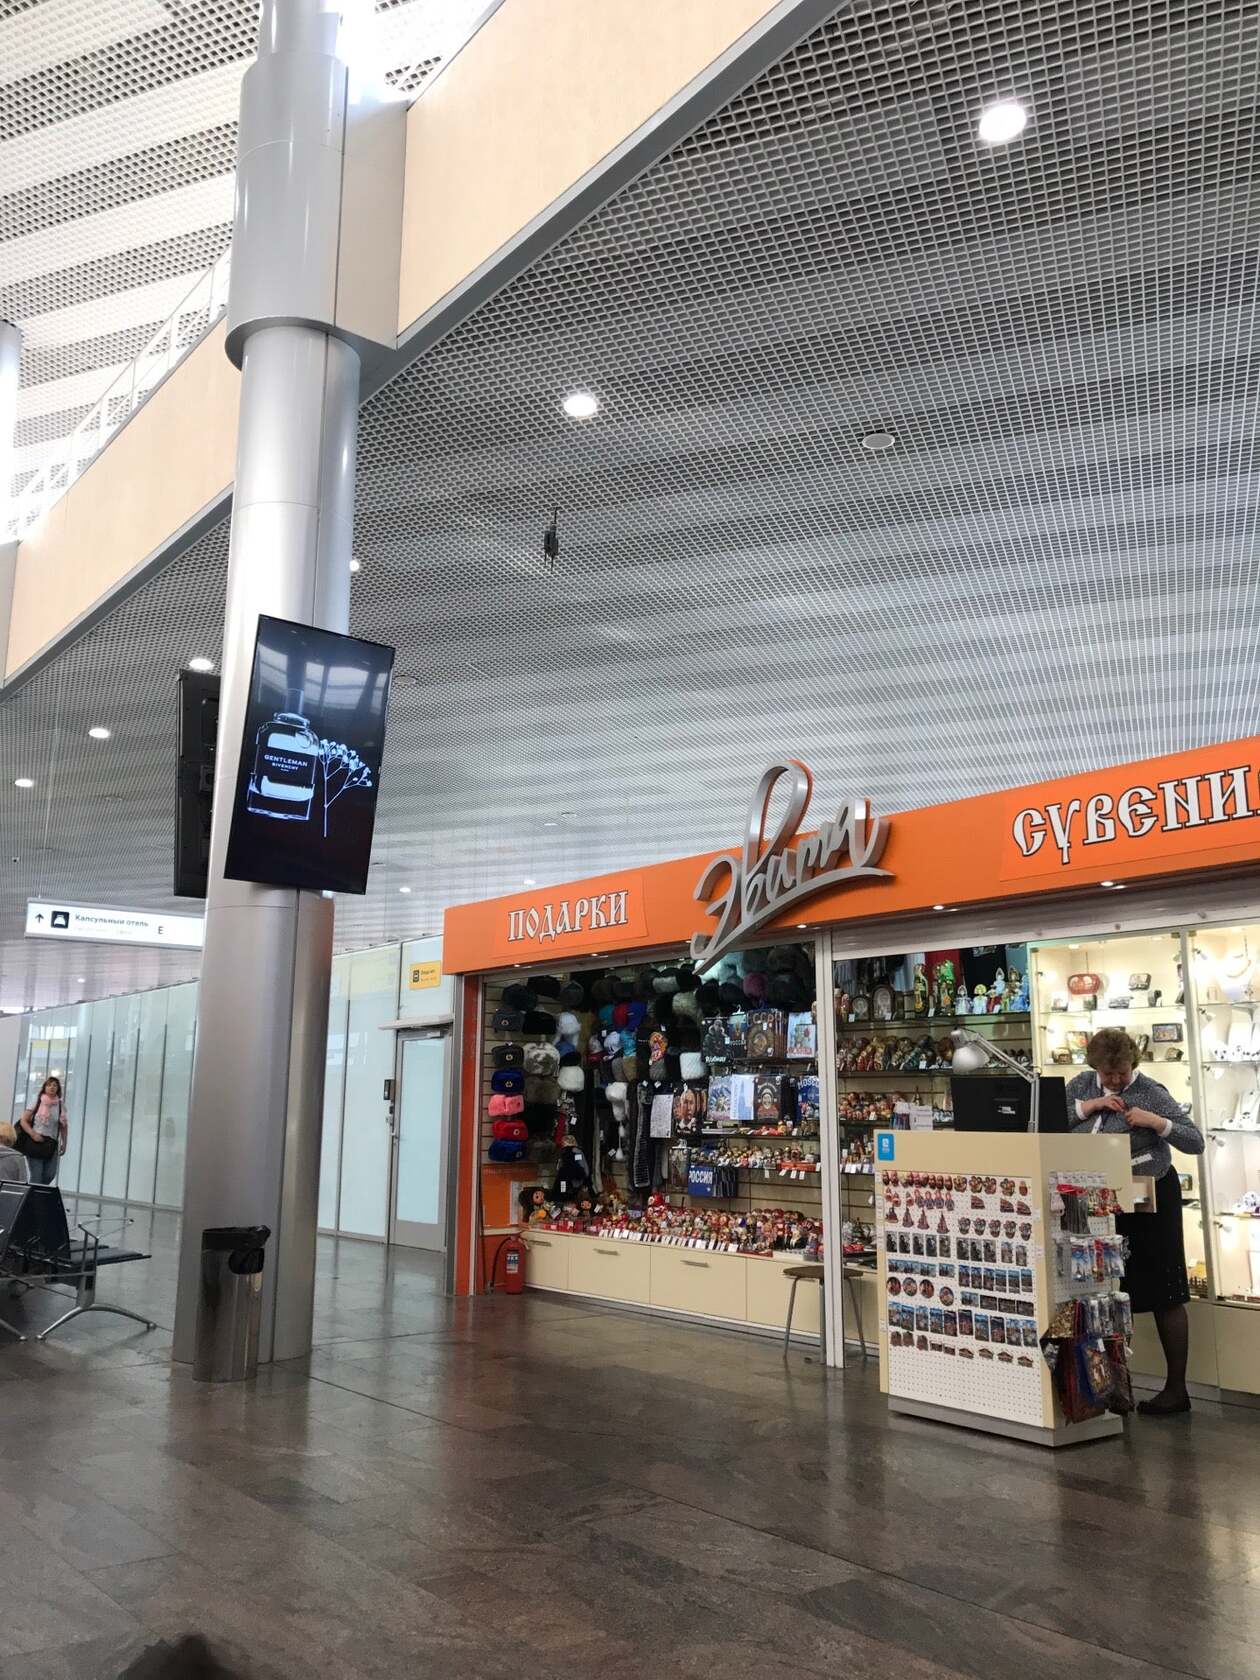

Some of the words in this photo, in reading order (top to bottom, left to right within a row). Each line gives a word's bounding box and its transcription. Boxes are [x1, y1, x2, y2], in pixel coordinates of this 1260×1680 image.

[264, 754, 308, 767] GENTLEMAN
[1012, 764, 1260, 865] СУВЕНИ
[126, 920, 149, 928] отель
[507, 890, 629, 944] ПОДАРКИ
[689, 1170, 713, 1184] РОССИЯ
